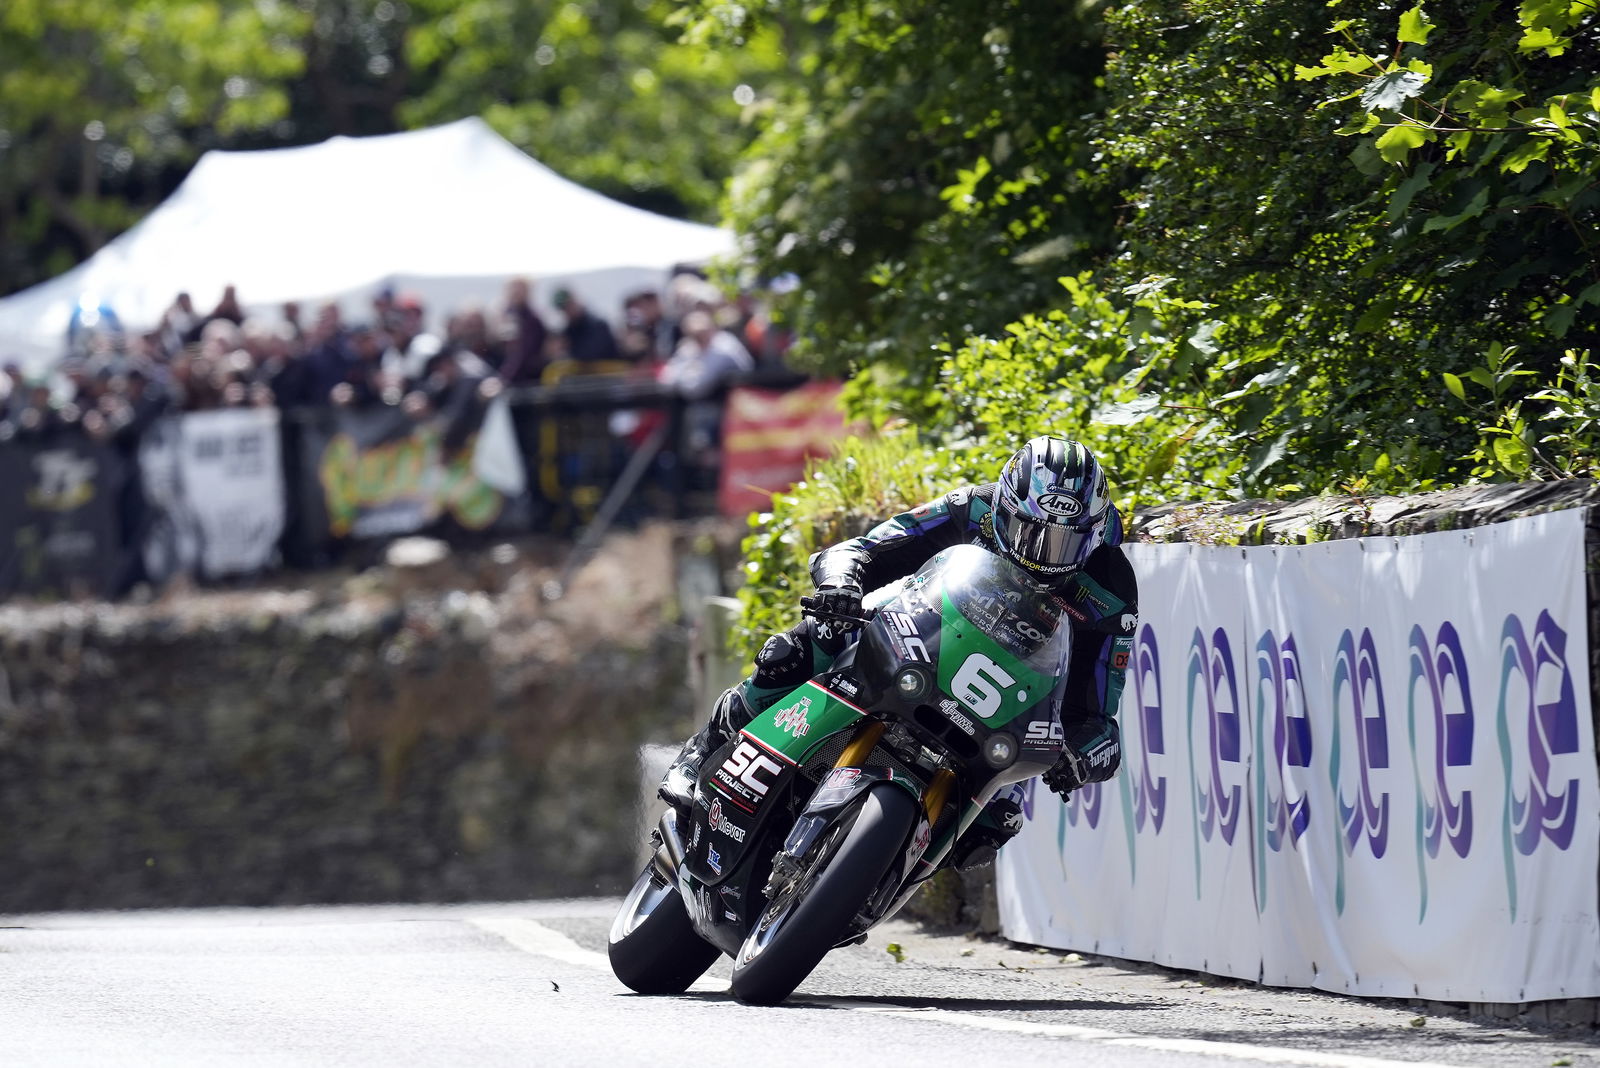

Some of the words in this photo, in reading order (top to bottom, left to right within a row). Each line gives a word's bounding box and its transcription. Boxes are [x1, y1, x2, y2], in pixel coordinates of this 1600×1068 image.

[1040, 495, 1077, 512] Arai
[1031, 517, 1080, 530] PARAMOUNT
[889, 611, 932, 663] SC
[951, 652, 1018, 719] 6
[1024, 720, 1063, 740] SC
[715, 768, 763, 803] PROJECT
[721, 741, 783, 796] SC
